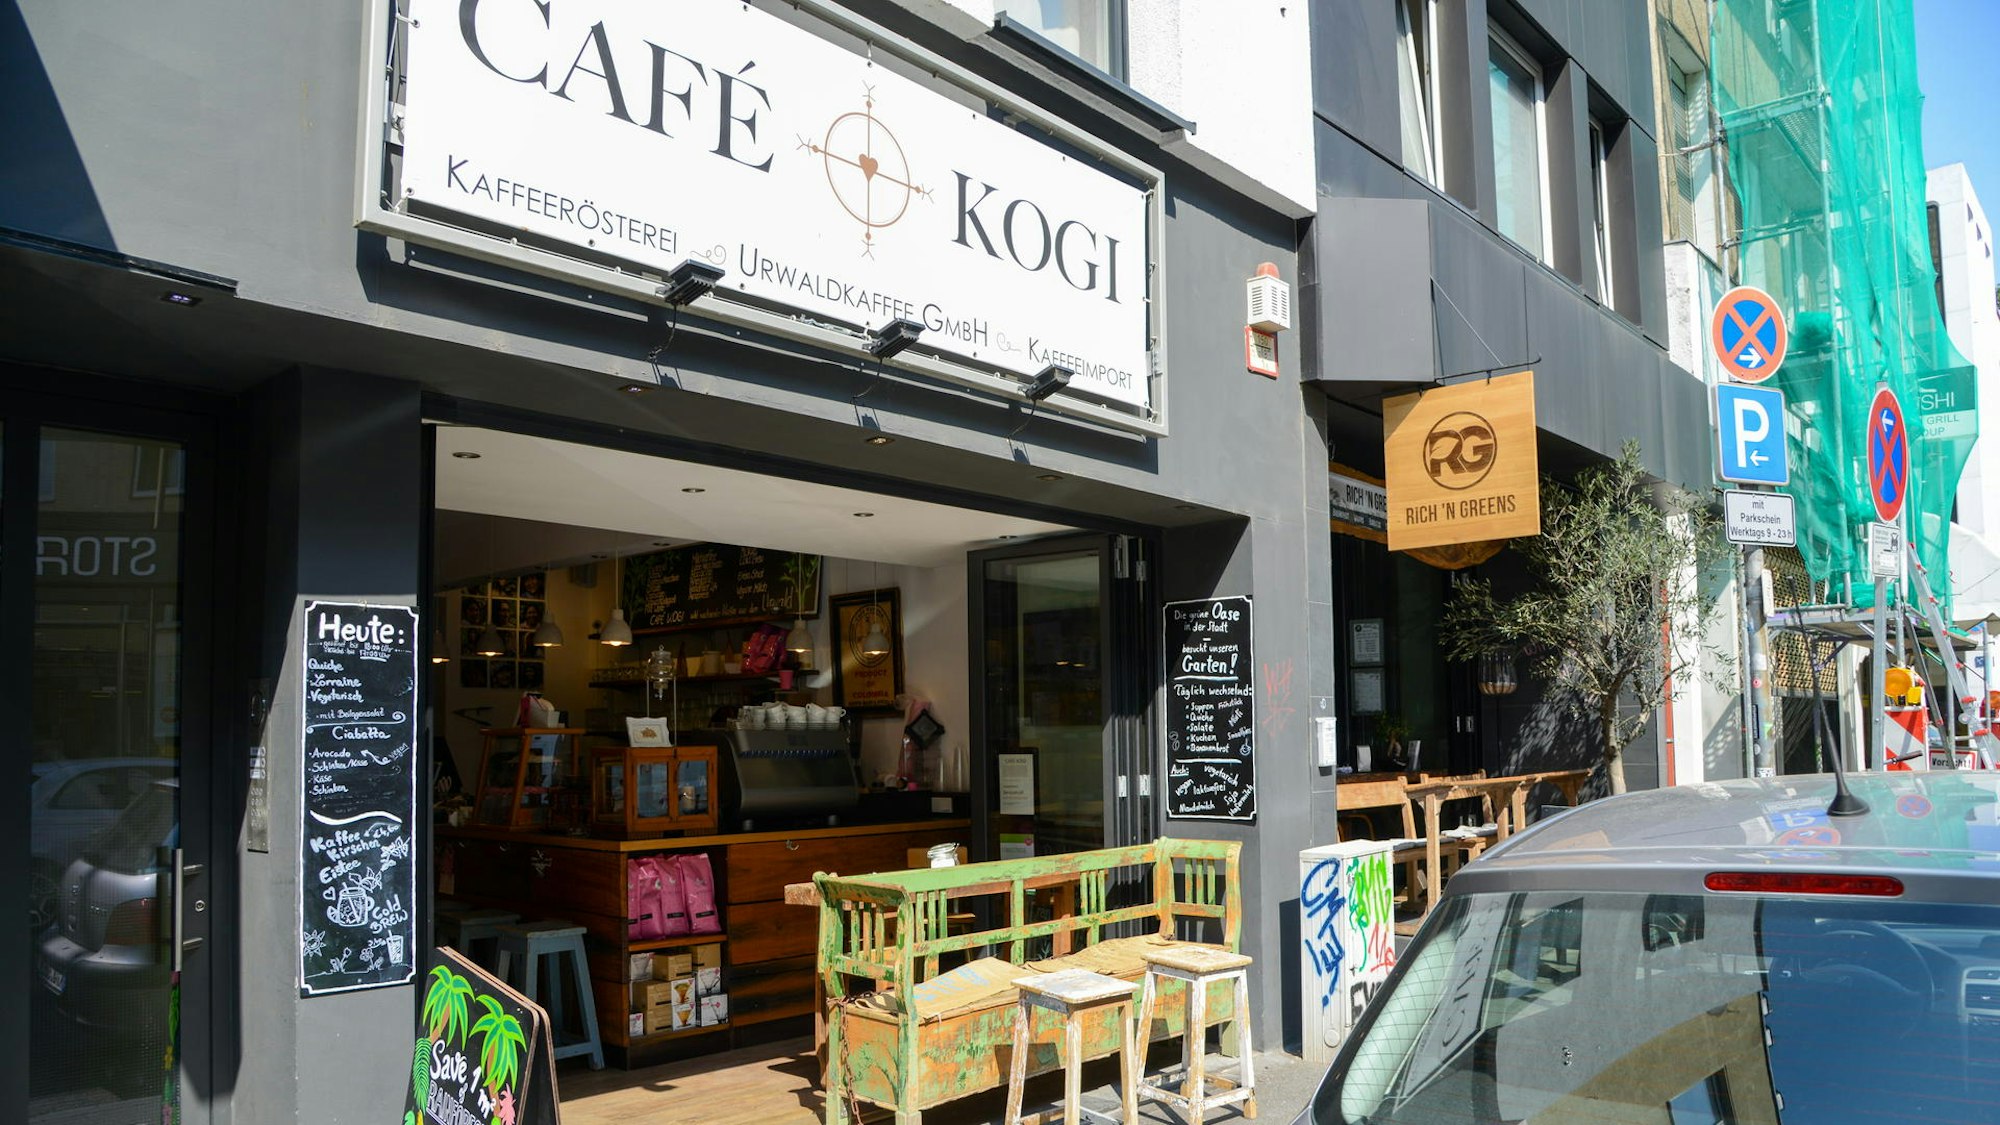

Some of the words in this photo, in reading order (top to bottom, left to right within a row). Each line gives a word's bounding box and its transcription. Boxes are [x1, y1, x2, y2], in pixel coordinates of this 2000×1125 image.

[459, 0, 774, 173] CAFÉ
[952, 169, 1122, 305] KOGI
[1927, 414, 1959, 425] GRILL
[1733, 397, 1770, 468] P
[1346, 485, 1364, 506] RICH
[1406, 506, 1438, 525] RICH
[1460, 495, 1516, 519] GREENS
[1752, 500, 1765, 510] mit
[1740, 513, 1781, 524] Parkschein
[1730, 526, 1766, 540] Werktags
[1766, 528, 1772, 538] 9
[1174, 610, 1187, 620] Die
[1212, 602, 1241, 621] Oase
[319, 612, 405, 645] Heute:
[1184, 620, 1191, 631] in
[1192, 621, 1206, 632] der
[1207, 620, 1228, 633] Stadt
[1182, 643, 1207, 653] besucht
[1208, 644, 1239, 653] unseren
[308, 658, 344, 674] Quiche
[1182, 653, 1239, 675] Garten!
[310, 674, 363, 688] Lorraine
[310, 688, 365, 705] Vegetarisch
[1174, 684, 1205, 700] Täglich
[319, 709, 336, 720] mit
[1190, 702, 1215, 713] Suppen
[1190, 711, 1214, 722] Quiche
[332, 726, 391, 741] Ciabatta
[1190, 722, 1214, 732] Salate
[1190, 732, 1217, 742] Kuchen
[311, 747, 351, 759] Avocado
[1931, 757, 1971, 768] Vorsht!
[313, 774, 333, 784] Käse
[311, 783, 350, 796] Schinken
[310, 830, 361, 854] Kaffee
[326, 839, 381, 862] Kirschen
[319, 859, 362, 884] Eistee
[372, 894, 402, 921] Cold
[370, 909, 409, 934] BREW
[430, 1039, 468, 1084] Save
